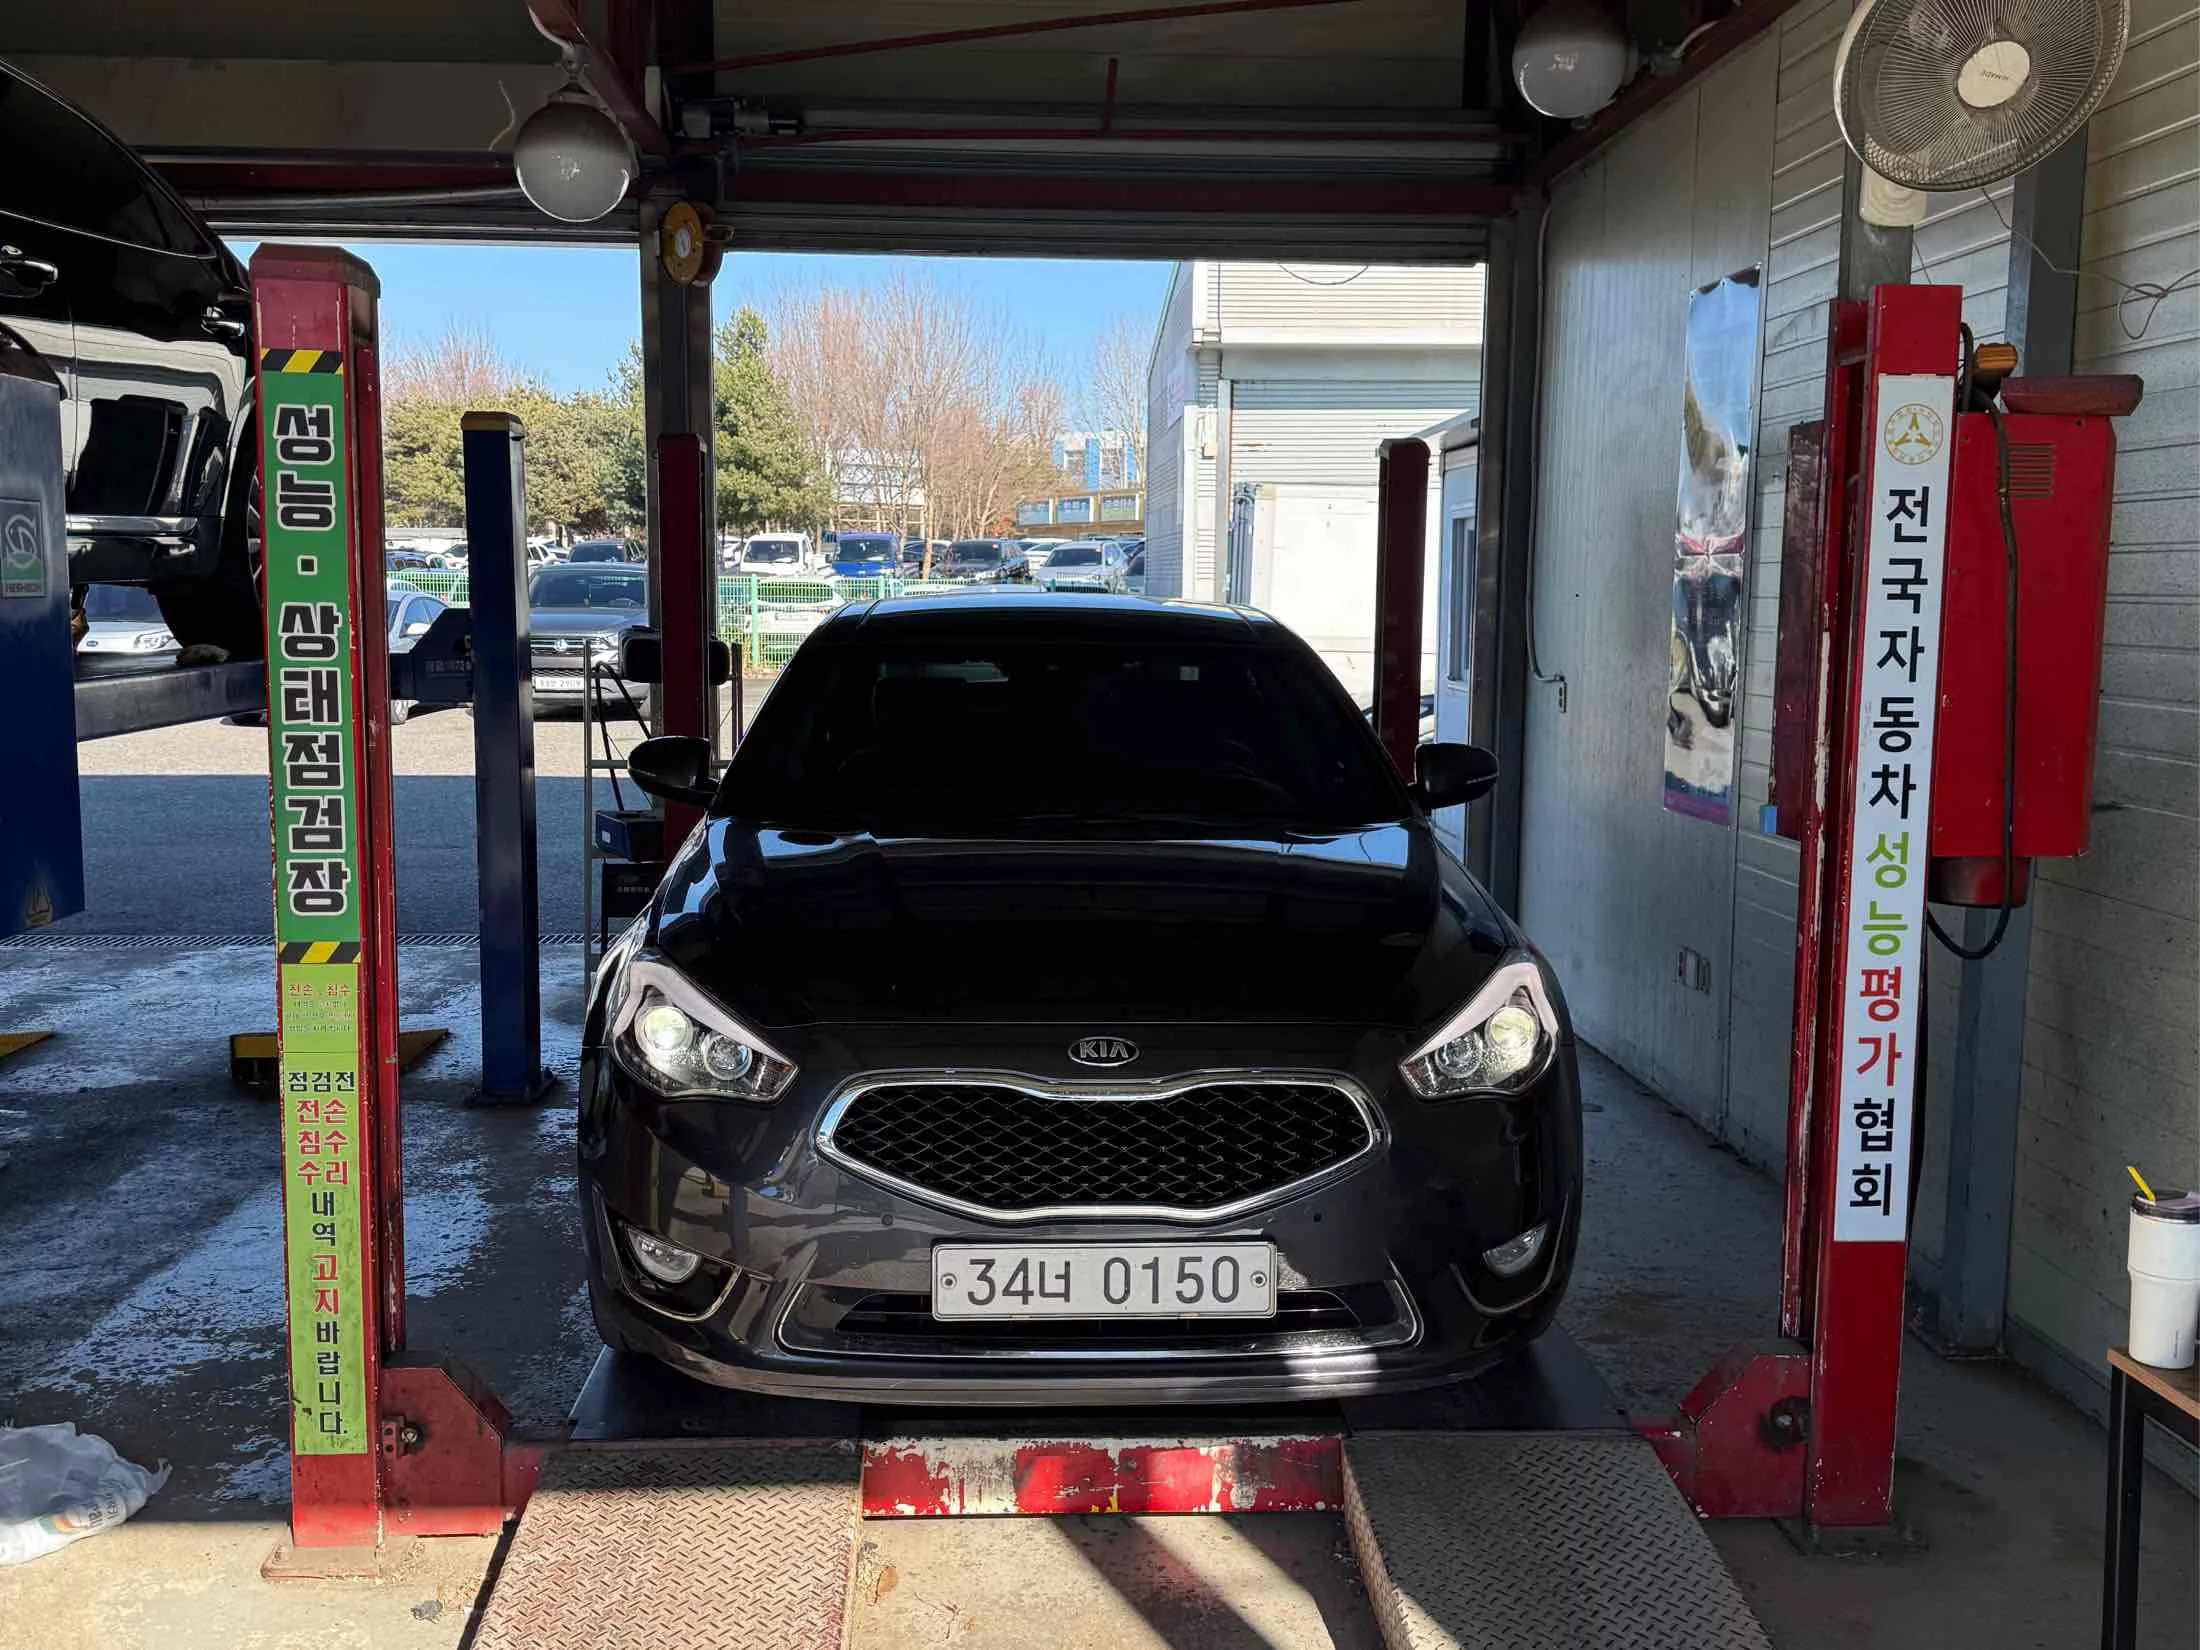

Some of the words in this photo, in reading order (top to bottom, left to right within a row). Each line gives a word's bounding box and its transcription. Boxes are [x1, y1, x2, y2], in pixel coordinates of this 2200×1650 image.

[1079, 1040, 1129, 1059] KIA
[288, 1071, 355, 1093] 점검전
[296, 1098, 348, 1125] 전손
[297, 1130, 349, 1155] 침수
[296, 1160, 348, 1186] 수리
[966, 1257, 1071, 1306] 34너
[1103, 1255, 1240, 1305] 0150
